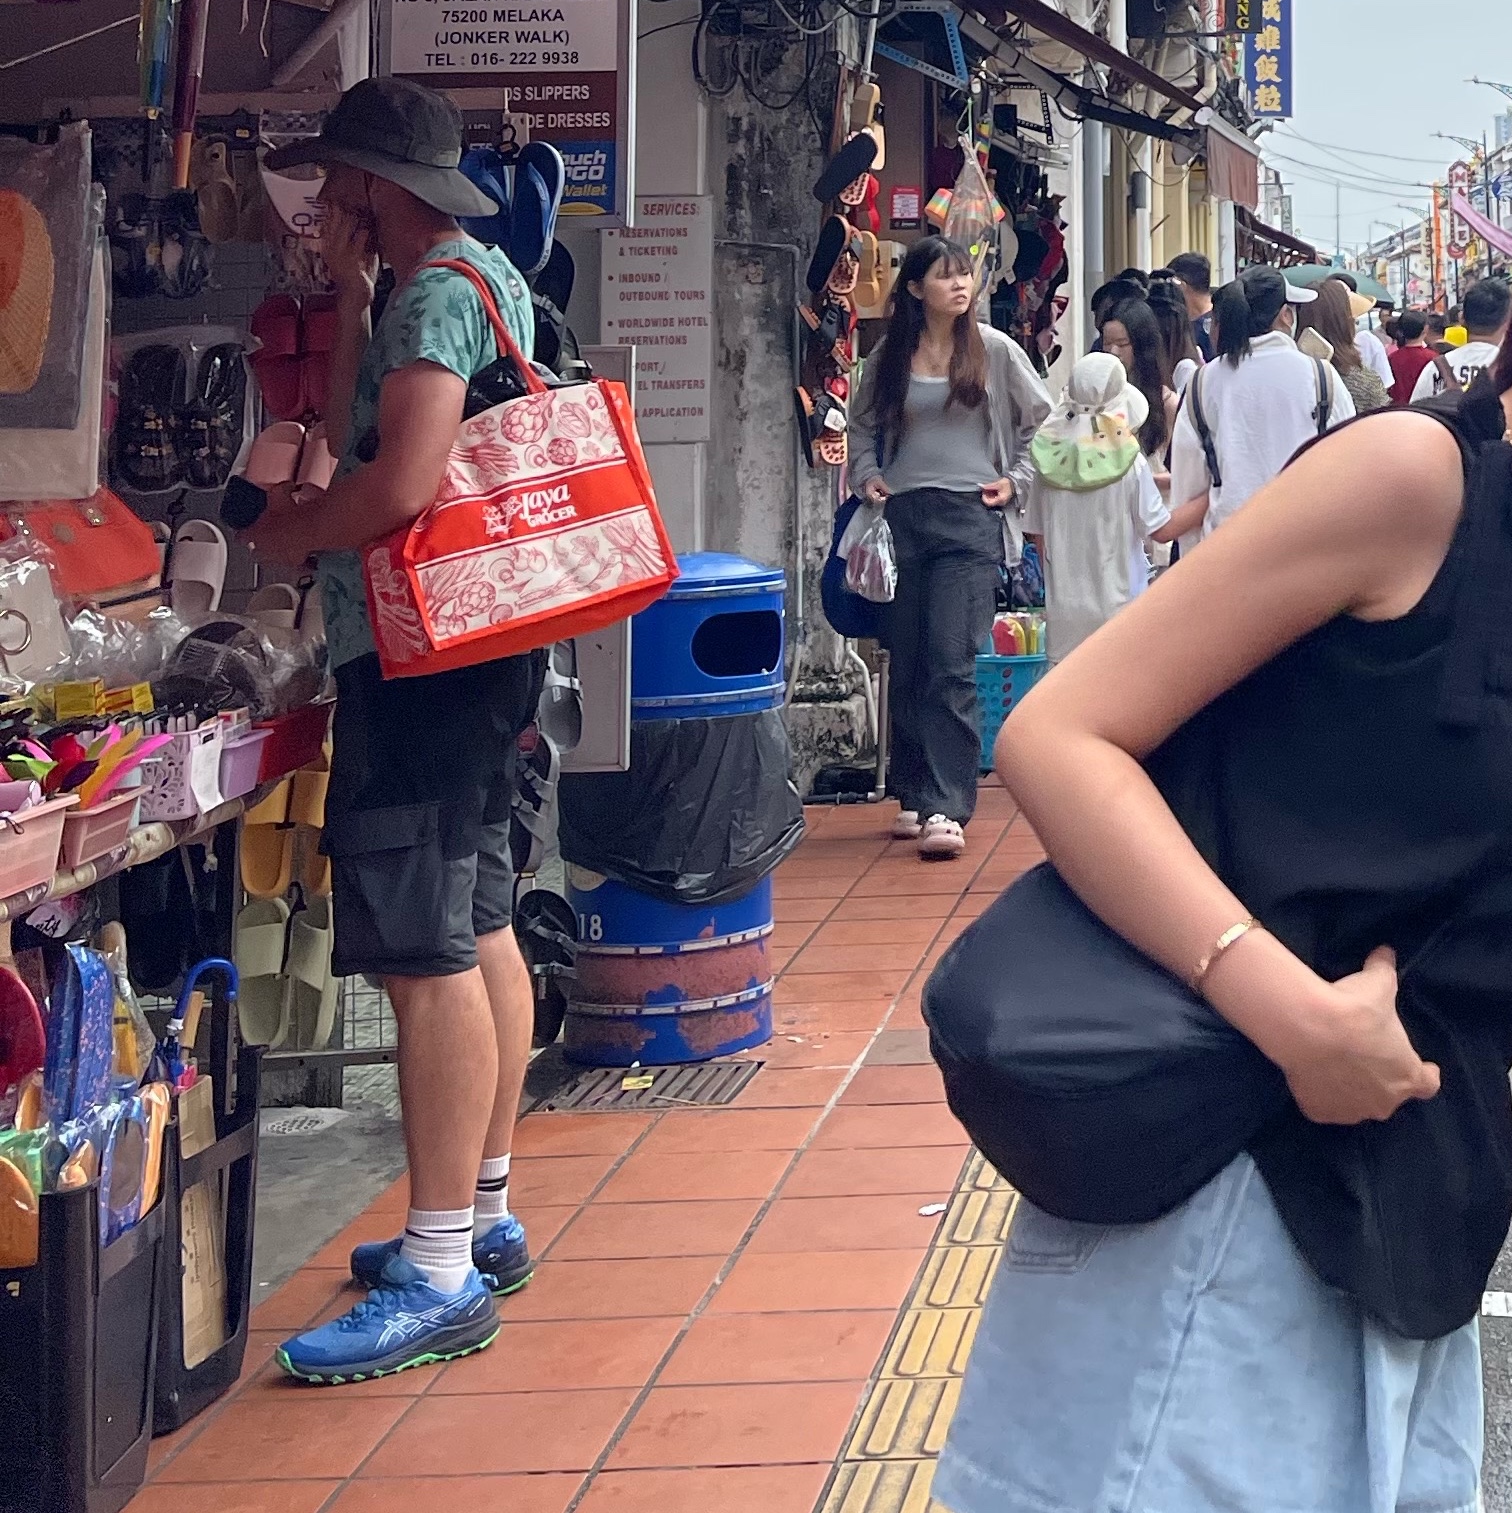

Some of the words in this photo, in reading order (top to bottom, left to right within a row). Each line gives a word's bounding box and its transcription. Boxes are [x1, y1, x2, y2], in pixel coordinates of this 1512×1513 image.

[441, 10, 488, 23] 75200
[493, 9, 565, 23] MELAKA
[434, 31, 510, 47] (JONKER
[515, 30, 570, 46] WALK)
[509, 52, 537, 65] 222
[542, 51, 579, 64] 9938
[525, 85, 590, 101] SLIPPERS
[547, 112, 611, 129] DRESSES
[619, 228, 688, 238] RESERVATIONS
[629, 246, 678, 256] TICKETING
[618, 273, 661, 283] INBOUND
[674, 290, 705, 301] TOURS
[618, 318, 675, 328] WORLDWIDE
[678, 316, 708, 327] HOTEL
[618, 335, 688, 345] RESERVATIONS
[651, 379, 705, 390] TRANSFERS
[642, 406, 704, 418] APPLICATION
[519, 484, 571, 519] Jaya
[526, 504, 577, 528] GROCER
